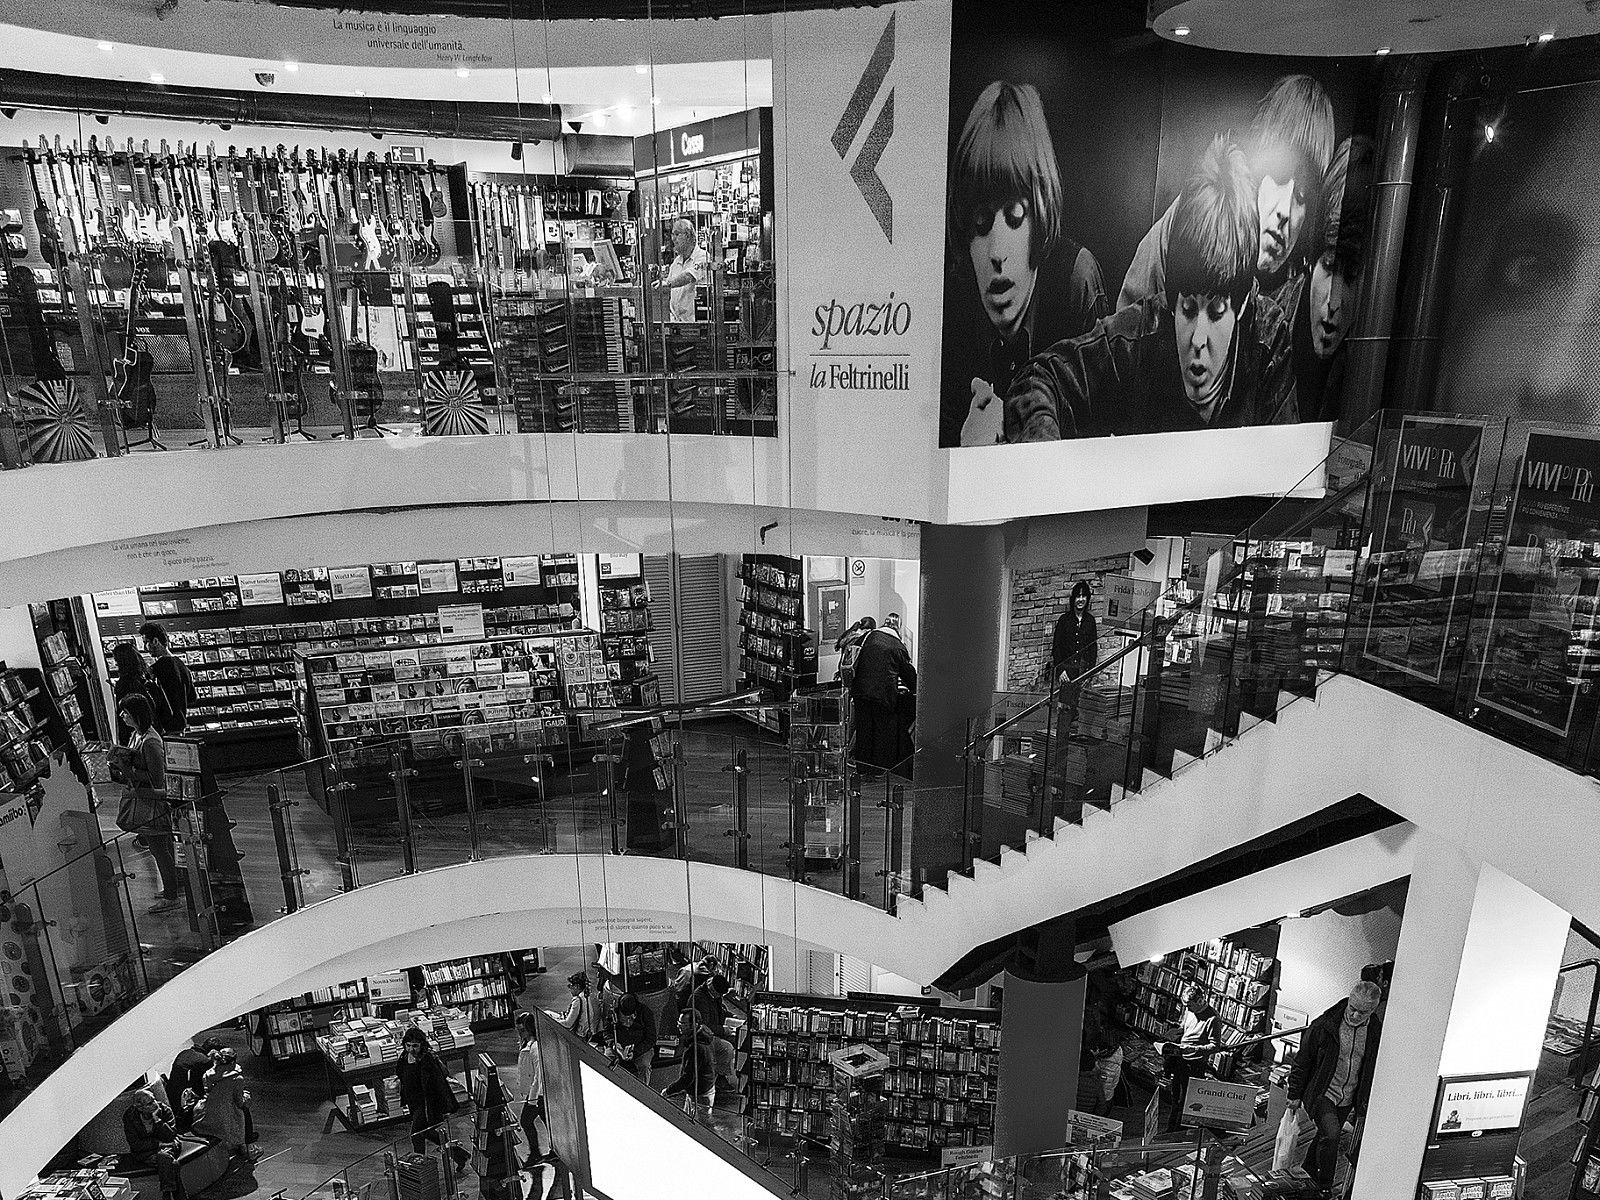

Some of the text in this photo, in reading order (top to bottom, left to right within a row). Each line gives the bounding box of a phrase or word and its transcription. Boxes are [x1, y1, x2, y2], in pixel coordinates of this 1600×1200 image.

[333, 18, 343, 30] La
[345, 20, 375, 32] musica
[392, 22, 437, 37] linguaggio
[367, 38, 410, 50] universale
[811, 291, 912, 351] spazio
[809, 362, 910, 391] la Feltrinelli
[1403, 444, 1431, 471] VIVI
[1528, 460, 1563, 492] VIVI
[1114, 585, 1131, 595] Frida
[1197, 1087, 1247, 1101] Grandi Chef
[1447, 1088, 1523, 1102] Libri, libri, libri...
